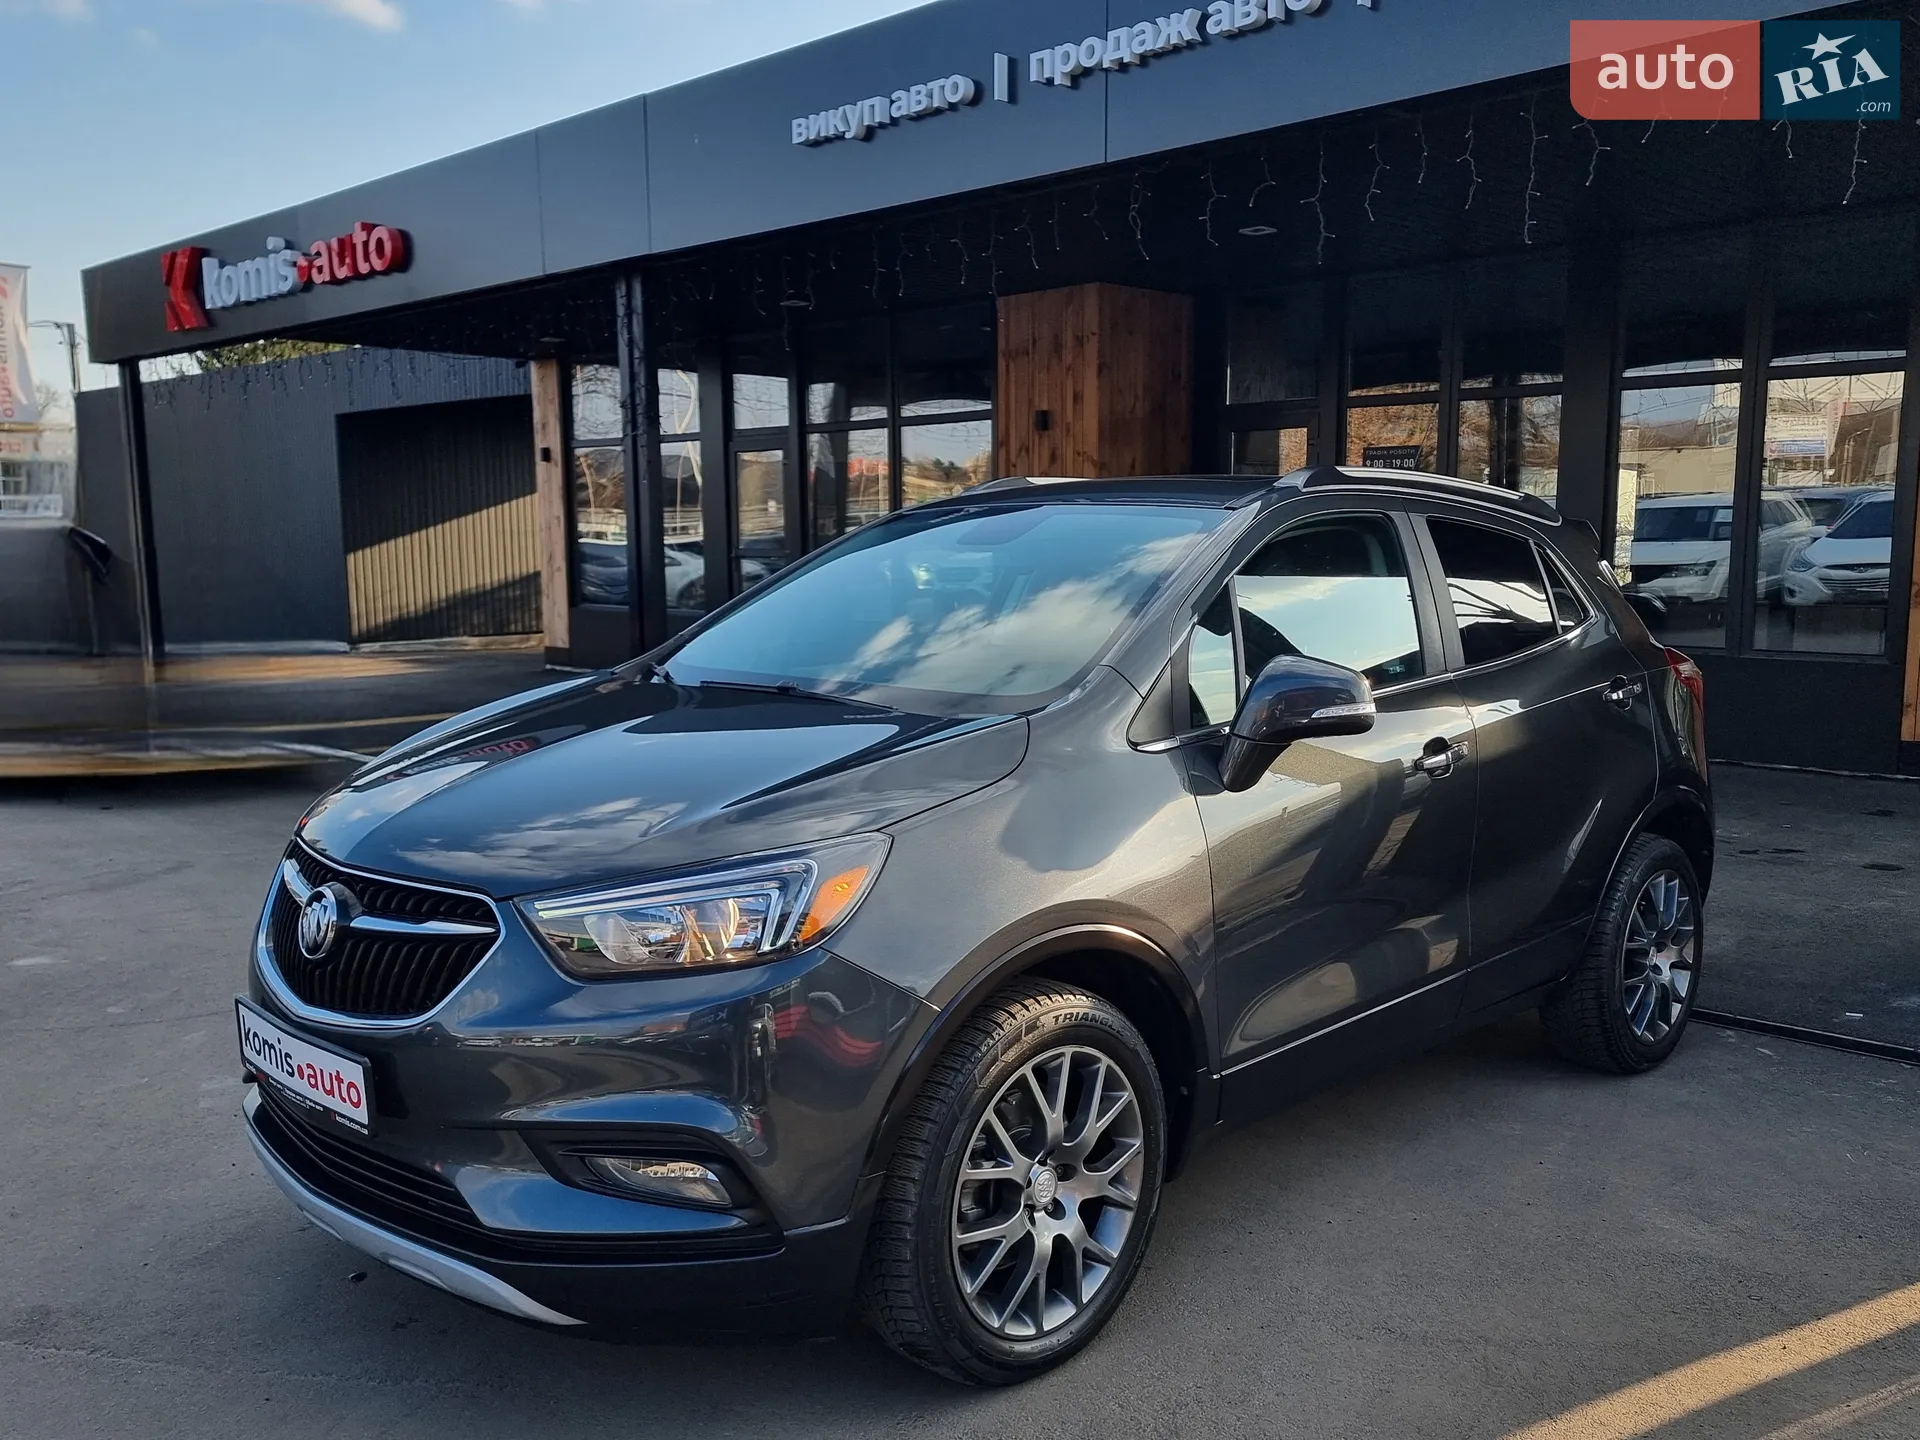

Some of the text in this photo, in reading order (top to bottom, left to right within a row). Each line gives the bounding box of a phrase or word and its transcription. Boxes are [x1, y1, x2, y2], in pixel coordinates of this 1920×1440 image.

[791, 95, 890, 145] викуп
[890, 73, 975, 120] авто
[1028, 7, 1203, 87] продаж
[1366, 459, 1384, 468] 9:00
[1392, 458, 1415, 468] 19:00
[1052, 1011, 1125, 1037] TRIANGLE
